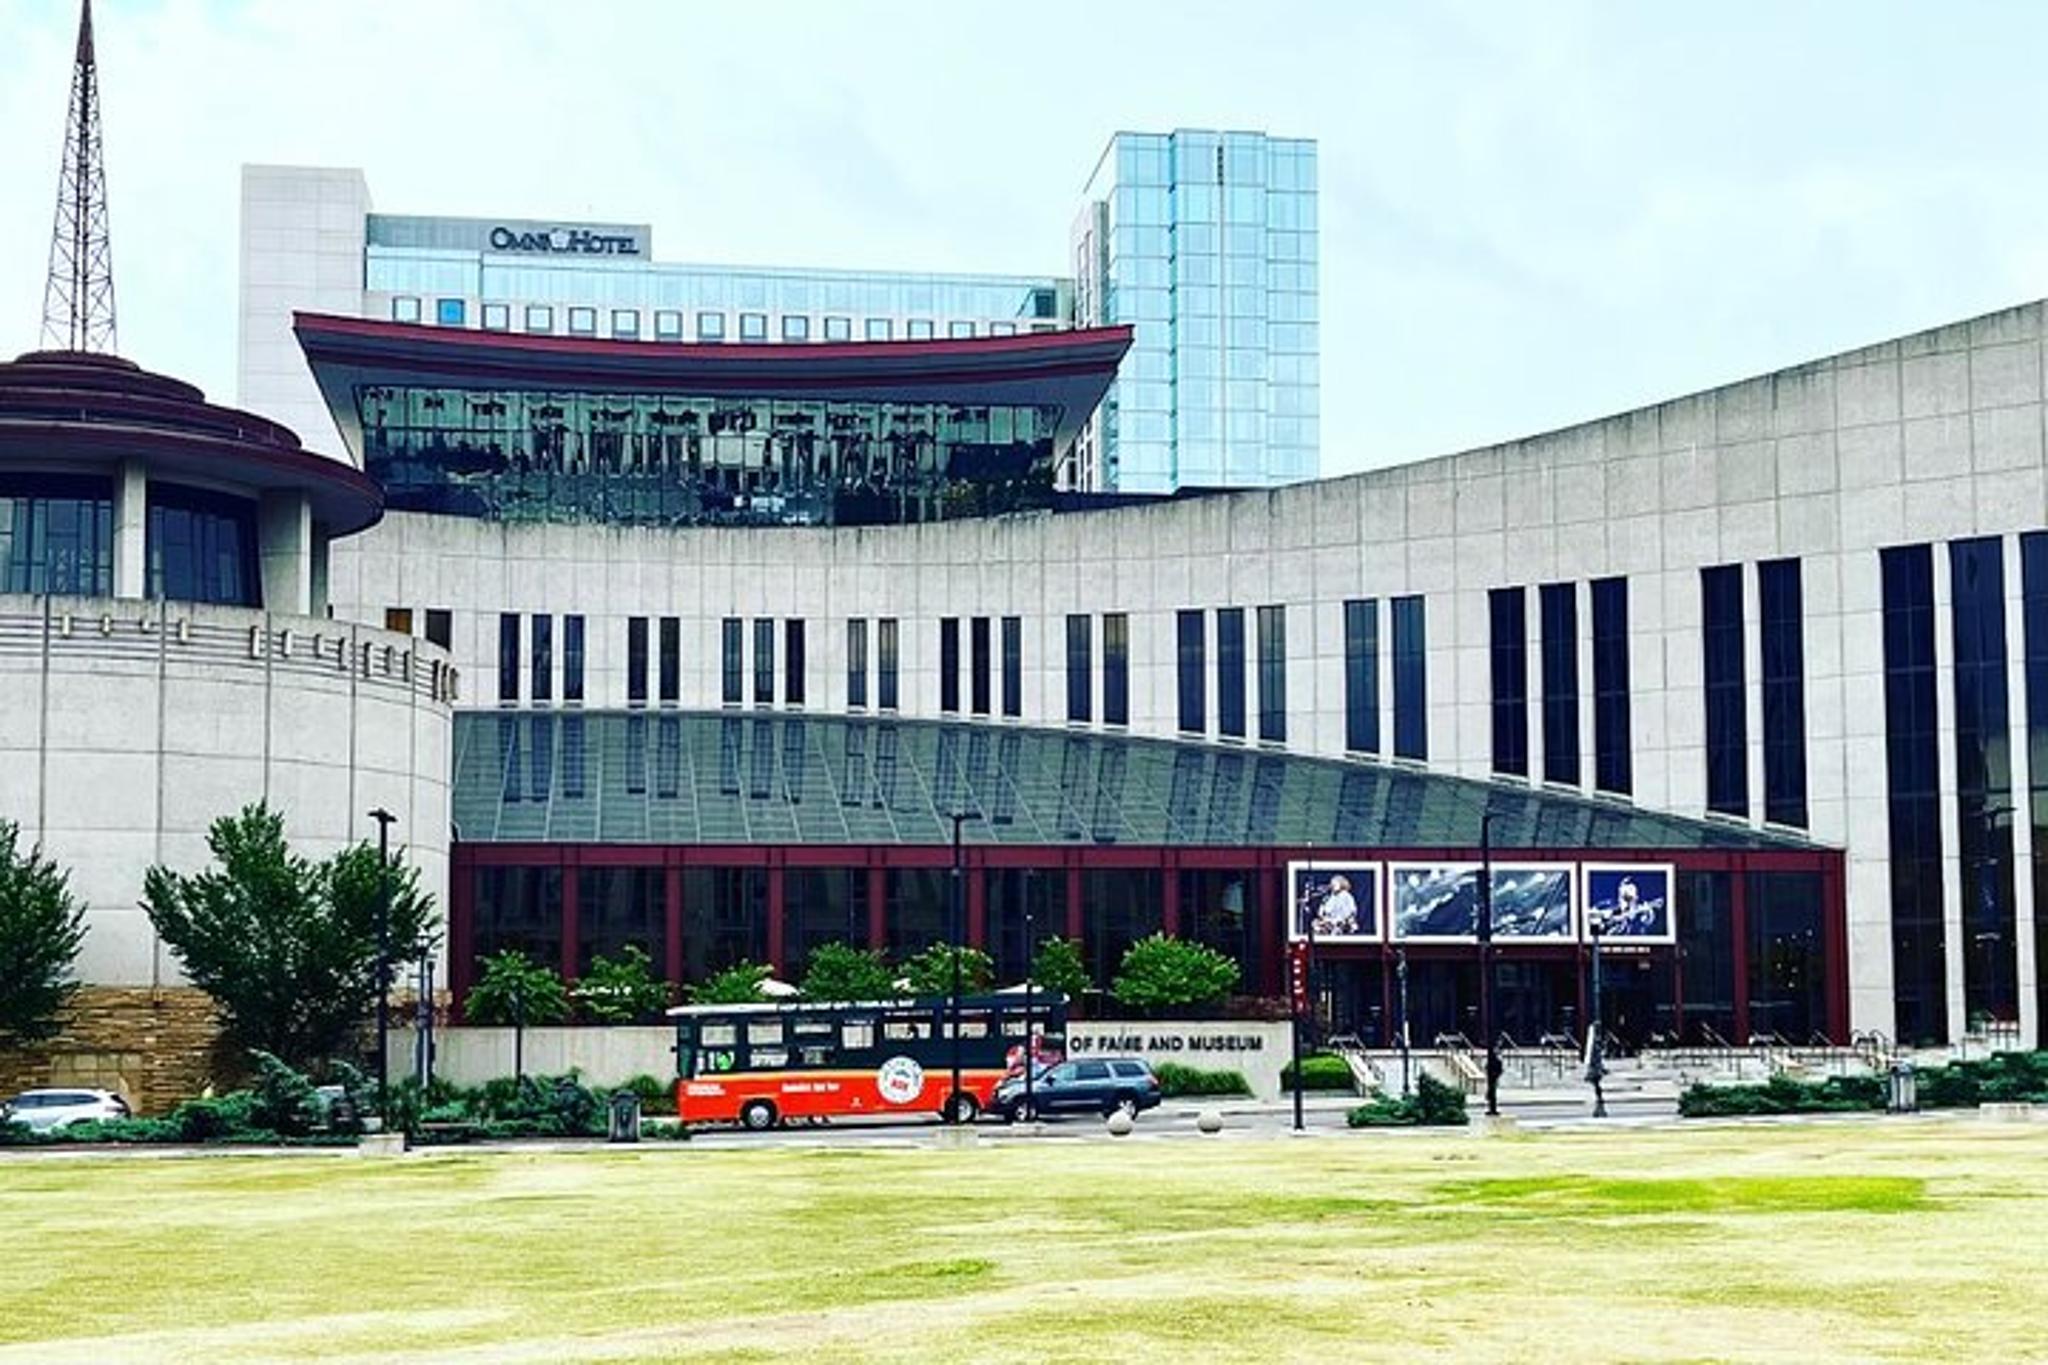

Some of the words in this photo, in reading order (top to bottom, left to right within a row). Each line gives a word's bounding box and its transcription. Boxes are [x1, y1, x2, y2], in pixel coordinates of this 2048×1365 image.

[570, 230, 640, 254] HOTEL
[1069, 1036, 1094, 1052] OF
[1098, 1036, 1144, 1052] FAME
[1148, 1036, 1185, 1052] AND
[1188, 1035, 1264, 1051] MUSEUM
